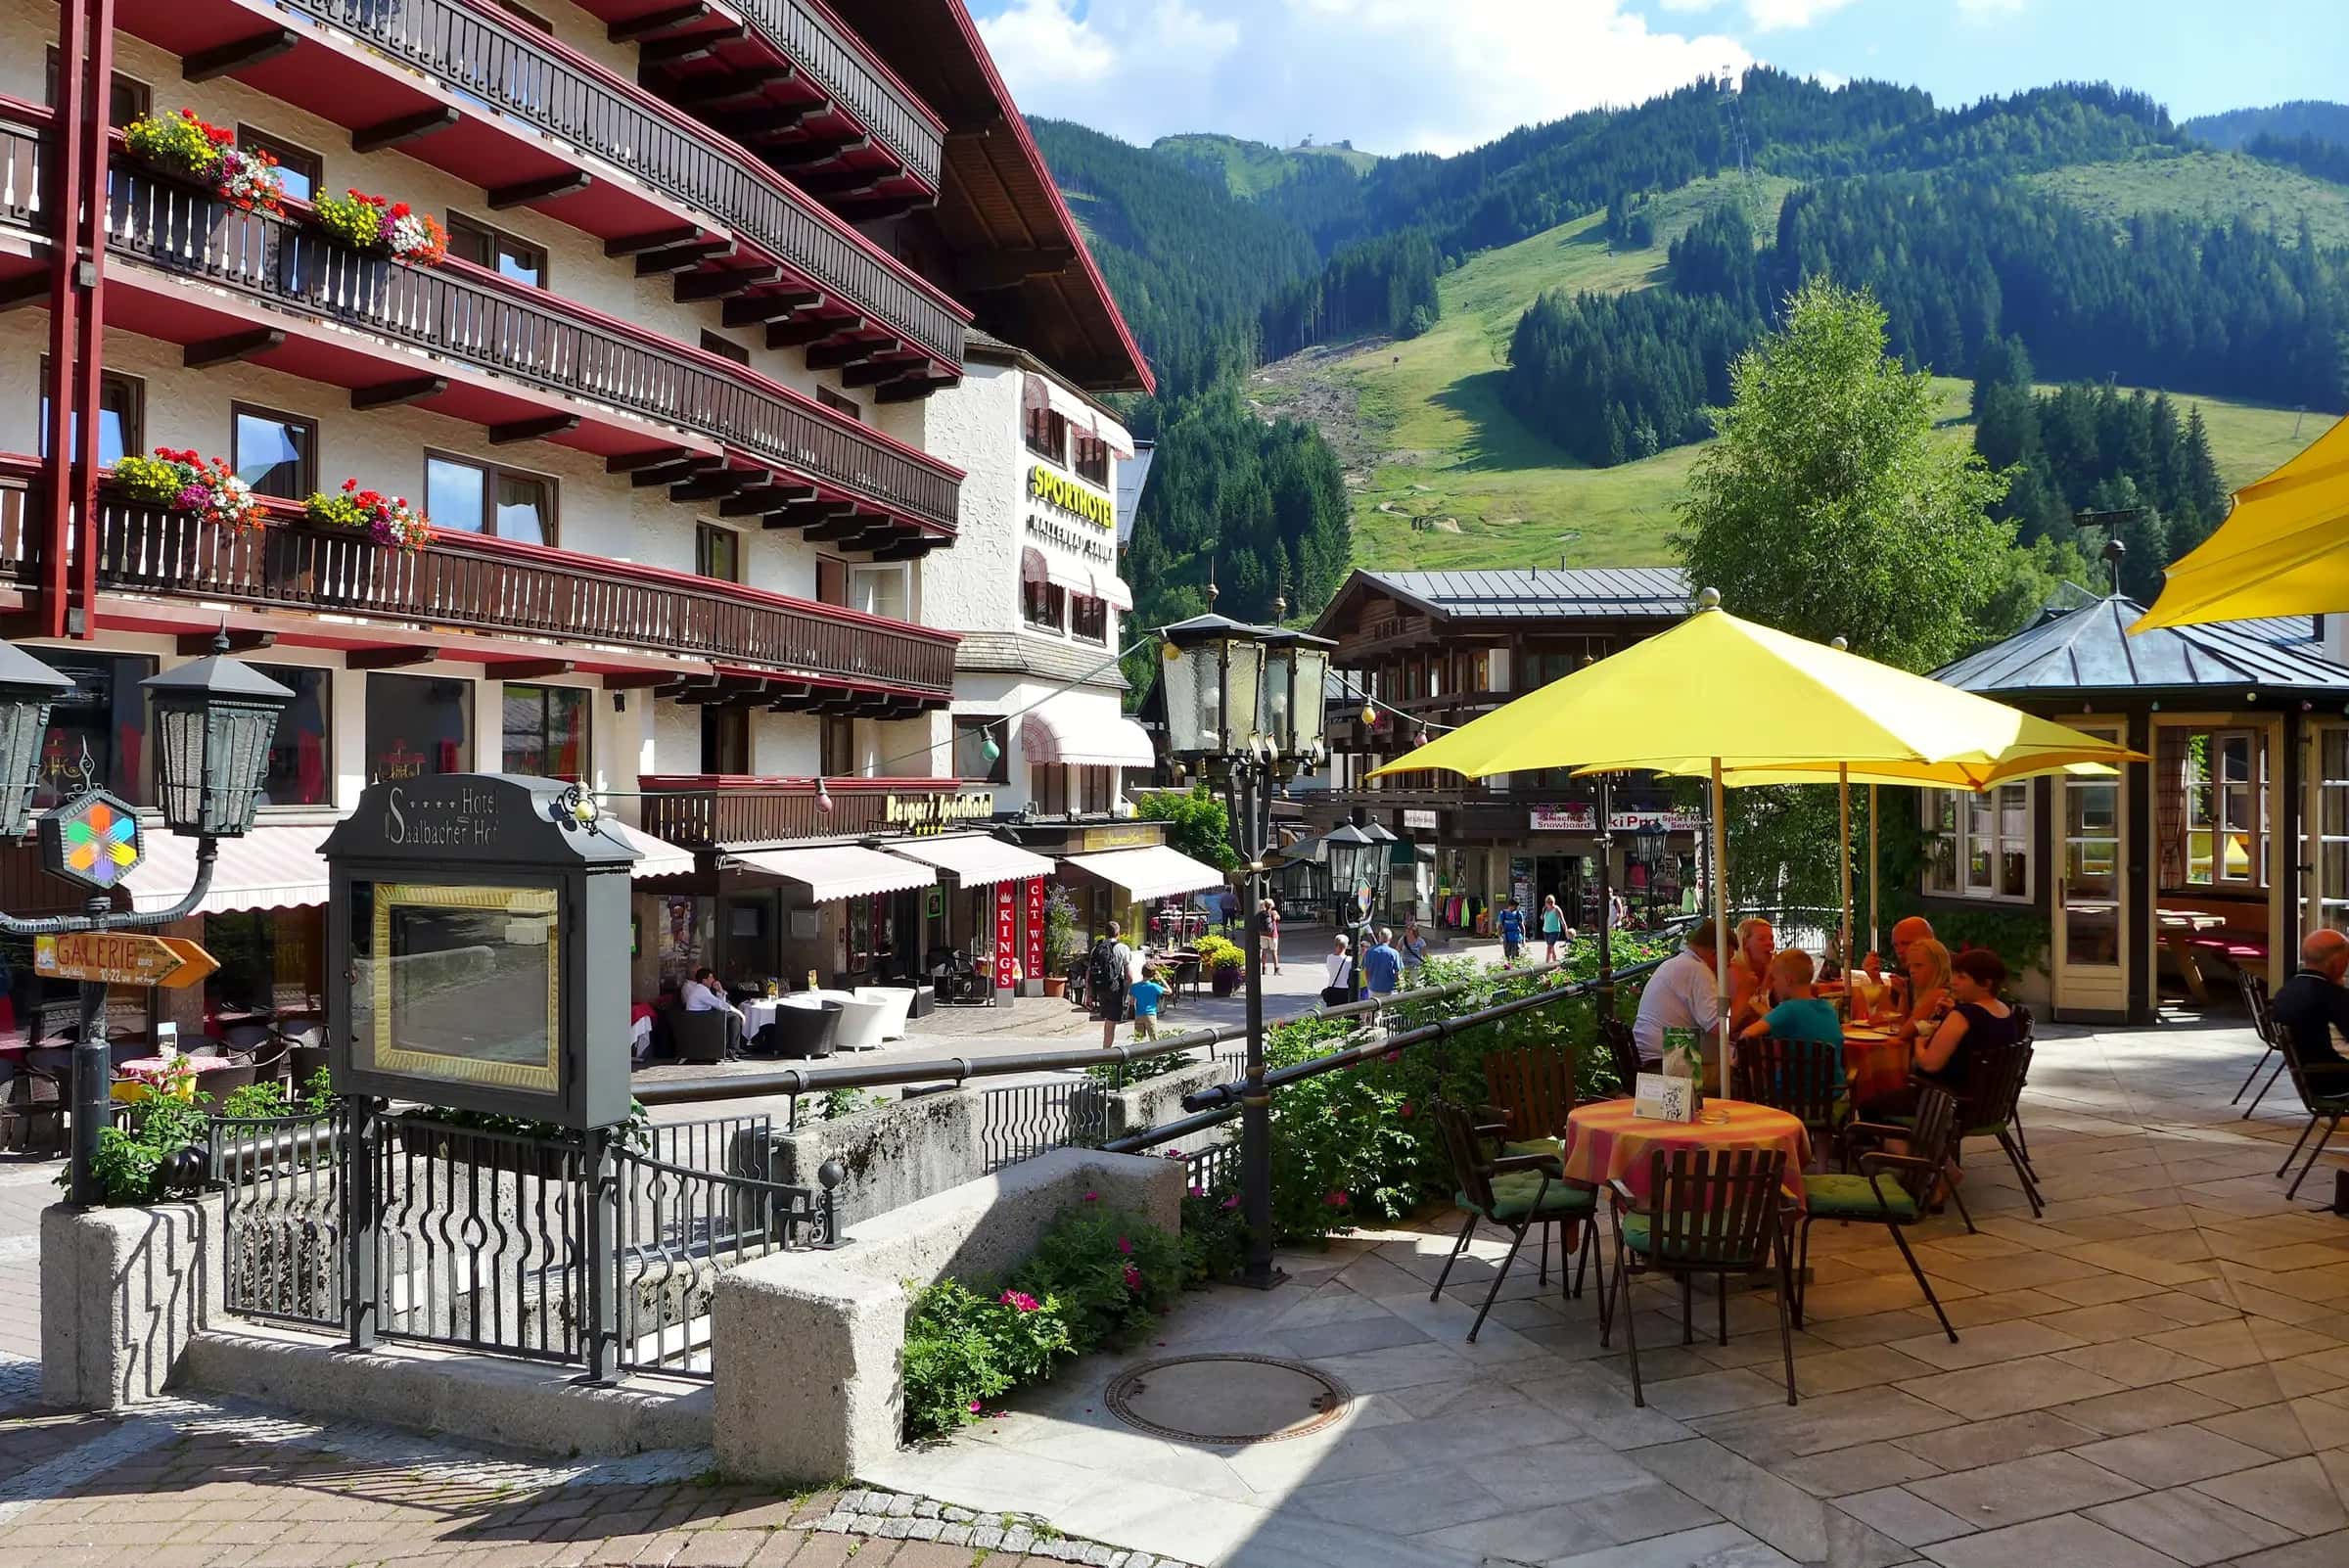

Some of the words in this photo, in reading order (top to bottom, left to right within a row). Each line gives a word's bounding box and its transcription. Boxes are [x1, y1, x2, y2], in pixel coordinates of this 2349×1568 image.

[390, 786, 469, 845] Saalbacher
[474, 819, 500, 846] Hof
[462, 787, 500, 814] Hotel
[1608, 815, 1625, 828] ki
[1030, 885, 1040, 919] CAT
[56, 936, 136, 970] GALERIE
[999, 909, 1012, 986] KINGS
[1029, 929, 1040, 977] WALK
